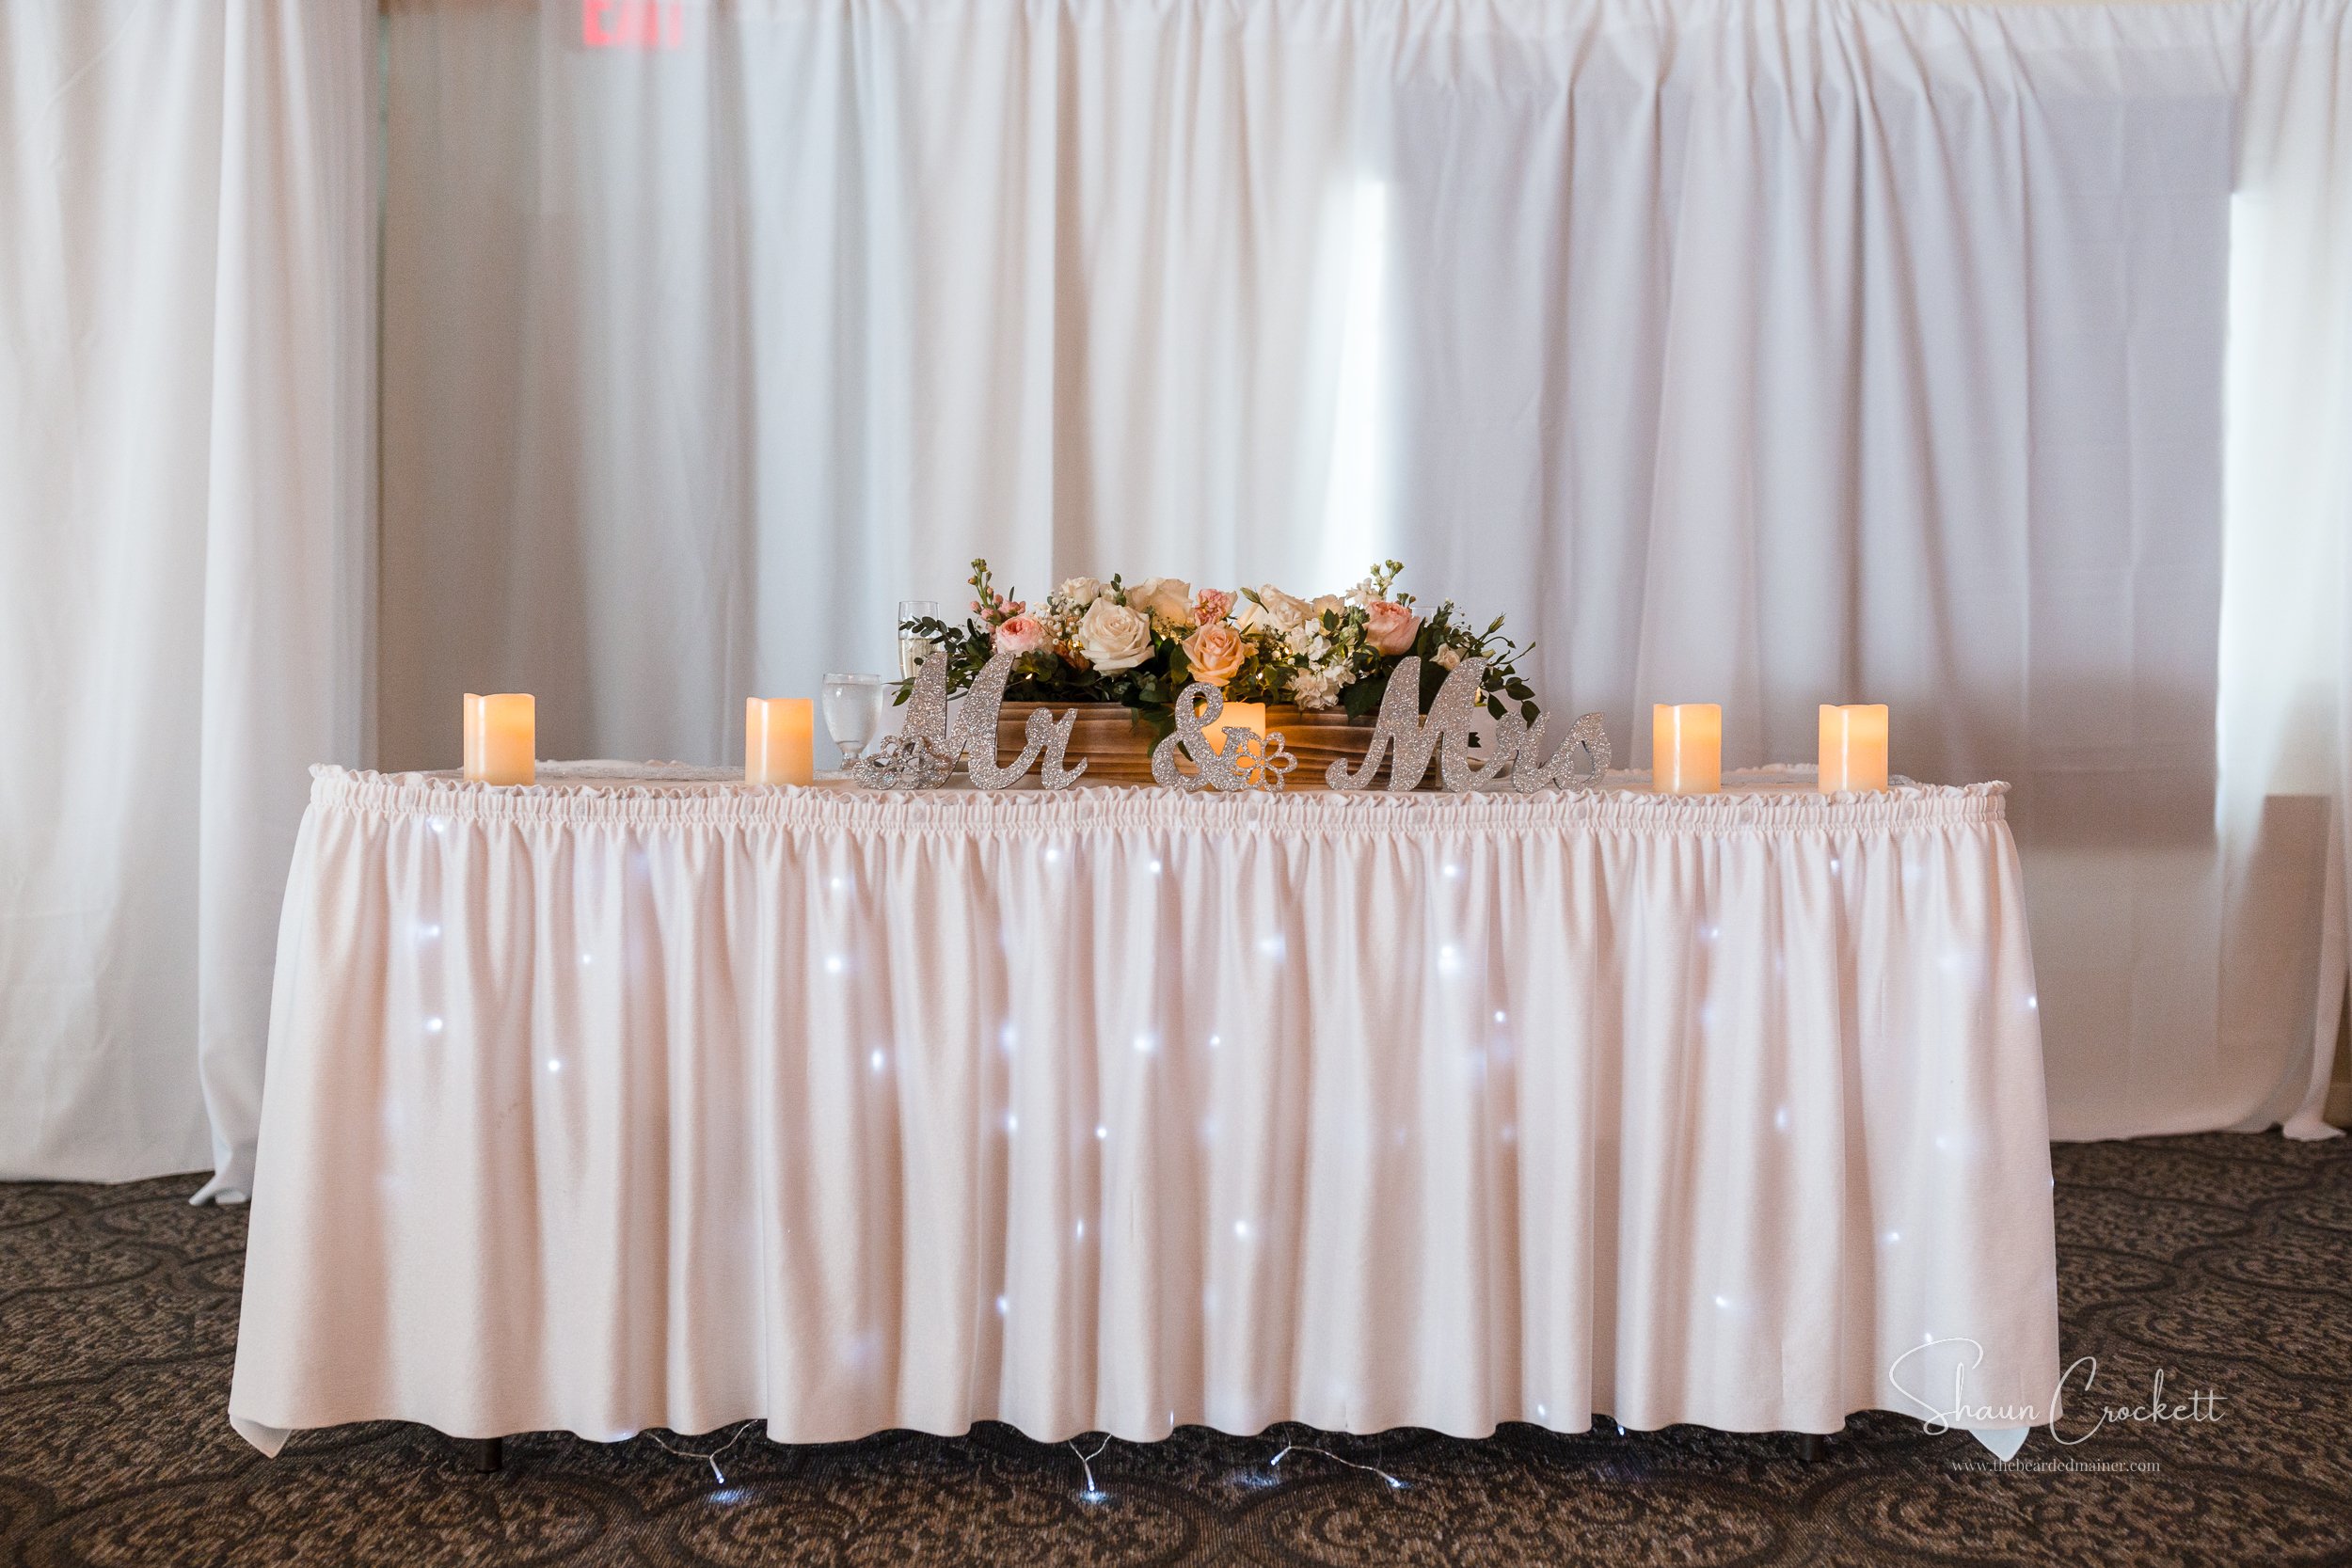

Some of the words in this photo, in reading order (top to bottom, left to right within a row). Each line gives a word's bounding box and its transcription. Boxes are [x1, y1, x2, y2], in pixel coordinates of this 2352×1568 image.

[852, 651, 1088, 791] Mr
[1152, 682, 1255, 792] &
[1325, 656, 1612, 793] Mrs
